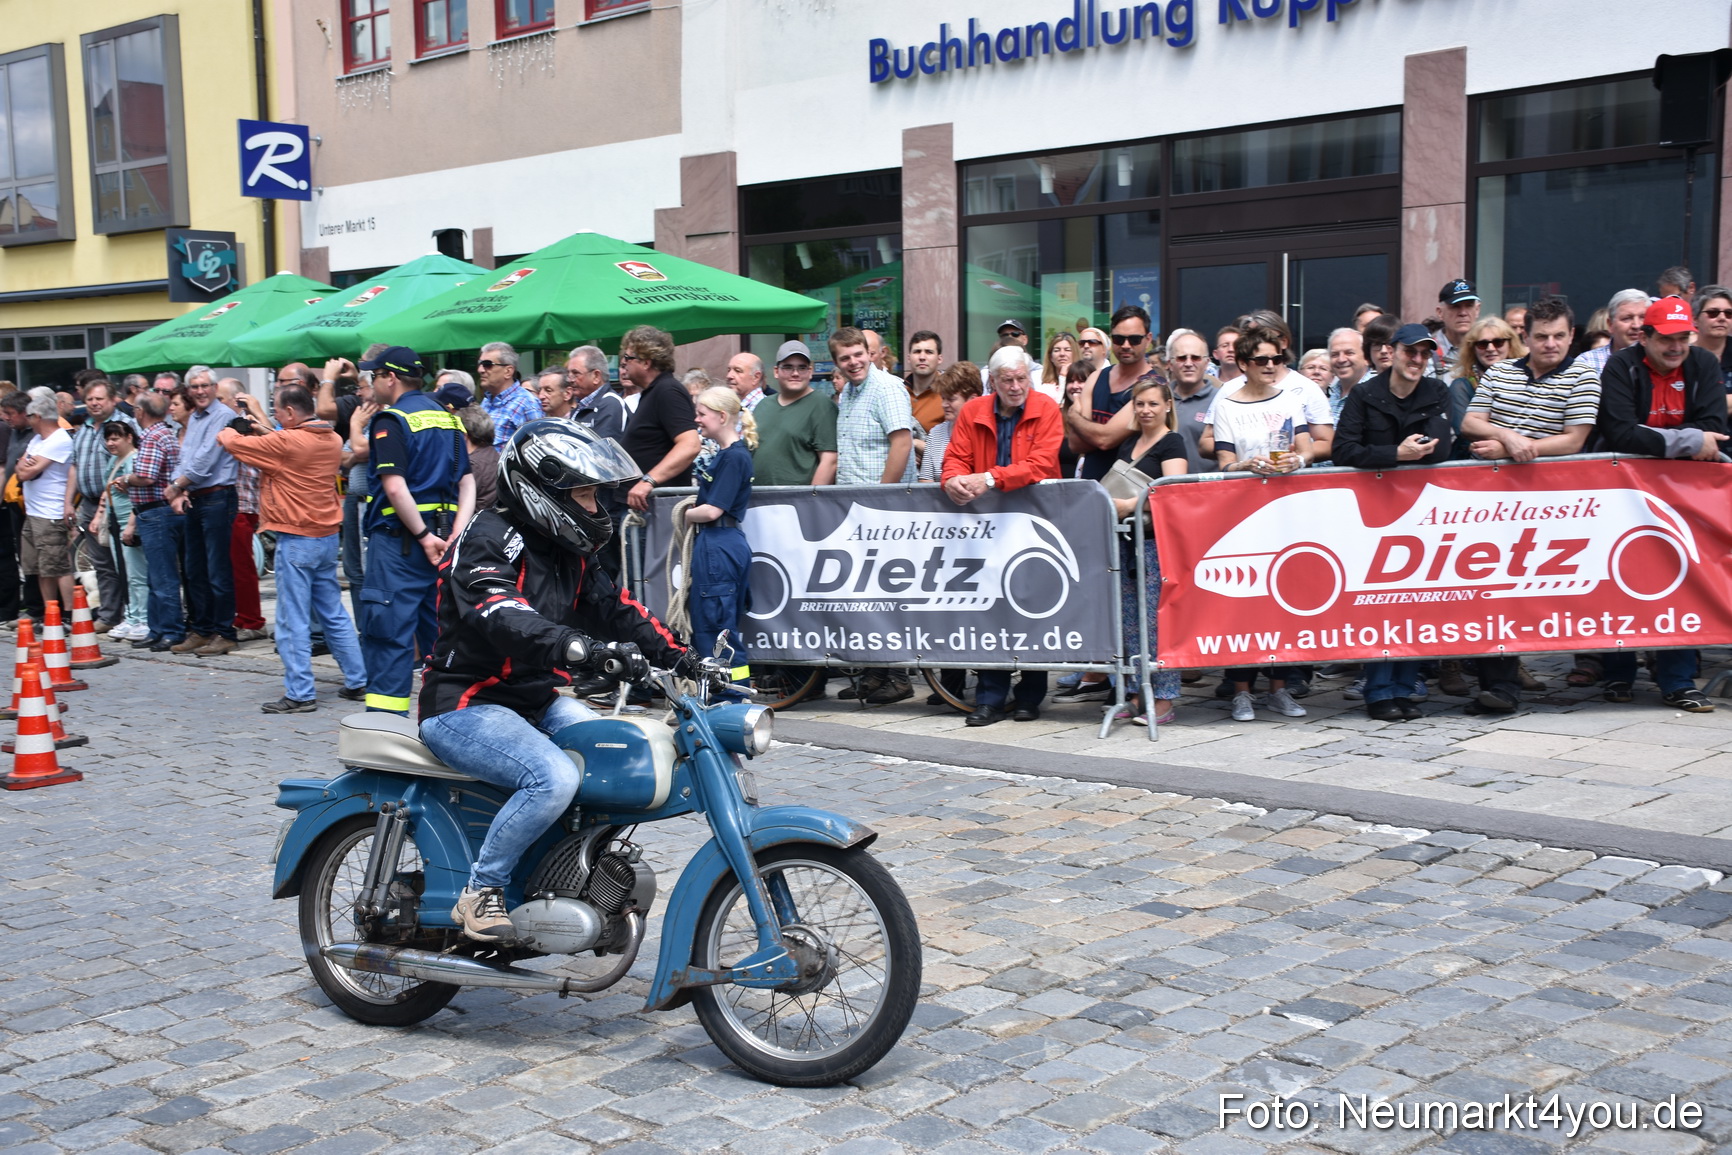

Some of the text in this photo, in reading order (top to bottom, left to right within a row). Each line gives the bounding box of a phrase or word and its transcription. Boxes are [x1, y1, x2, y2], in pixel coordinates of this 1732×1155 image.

[869, 0, 1196, 83] Buchhandlung
[319, 217, 376, 237] Unterer Markt 15
[197, 250, 221, 280] G2
[857, 310, 890, 320] GARTEN
[863, 320, 886, 329] BUCH
[1416, 497, 1601, 526] Autoklassik
[846, 520, 997, 542] Autoklassik
[805, 546, 986, 593] Dietz
[1363, 527, 1591, 585] Dietz
[799, 601, 898, 613] BREITENBRUNN
[1353, 589, 1478, 606] BREITENBRUNN
[742, 625, 1084, 652] .autoklassik-dietz.de
[1196, 607, 1702, 655] www.autoklassik-dietz.de
